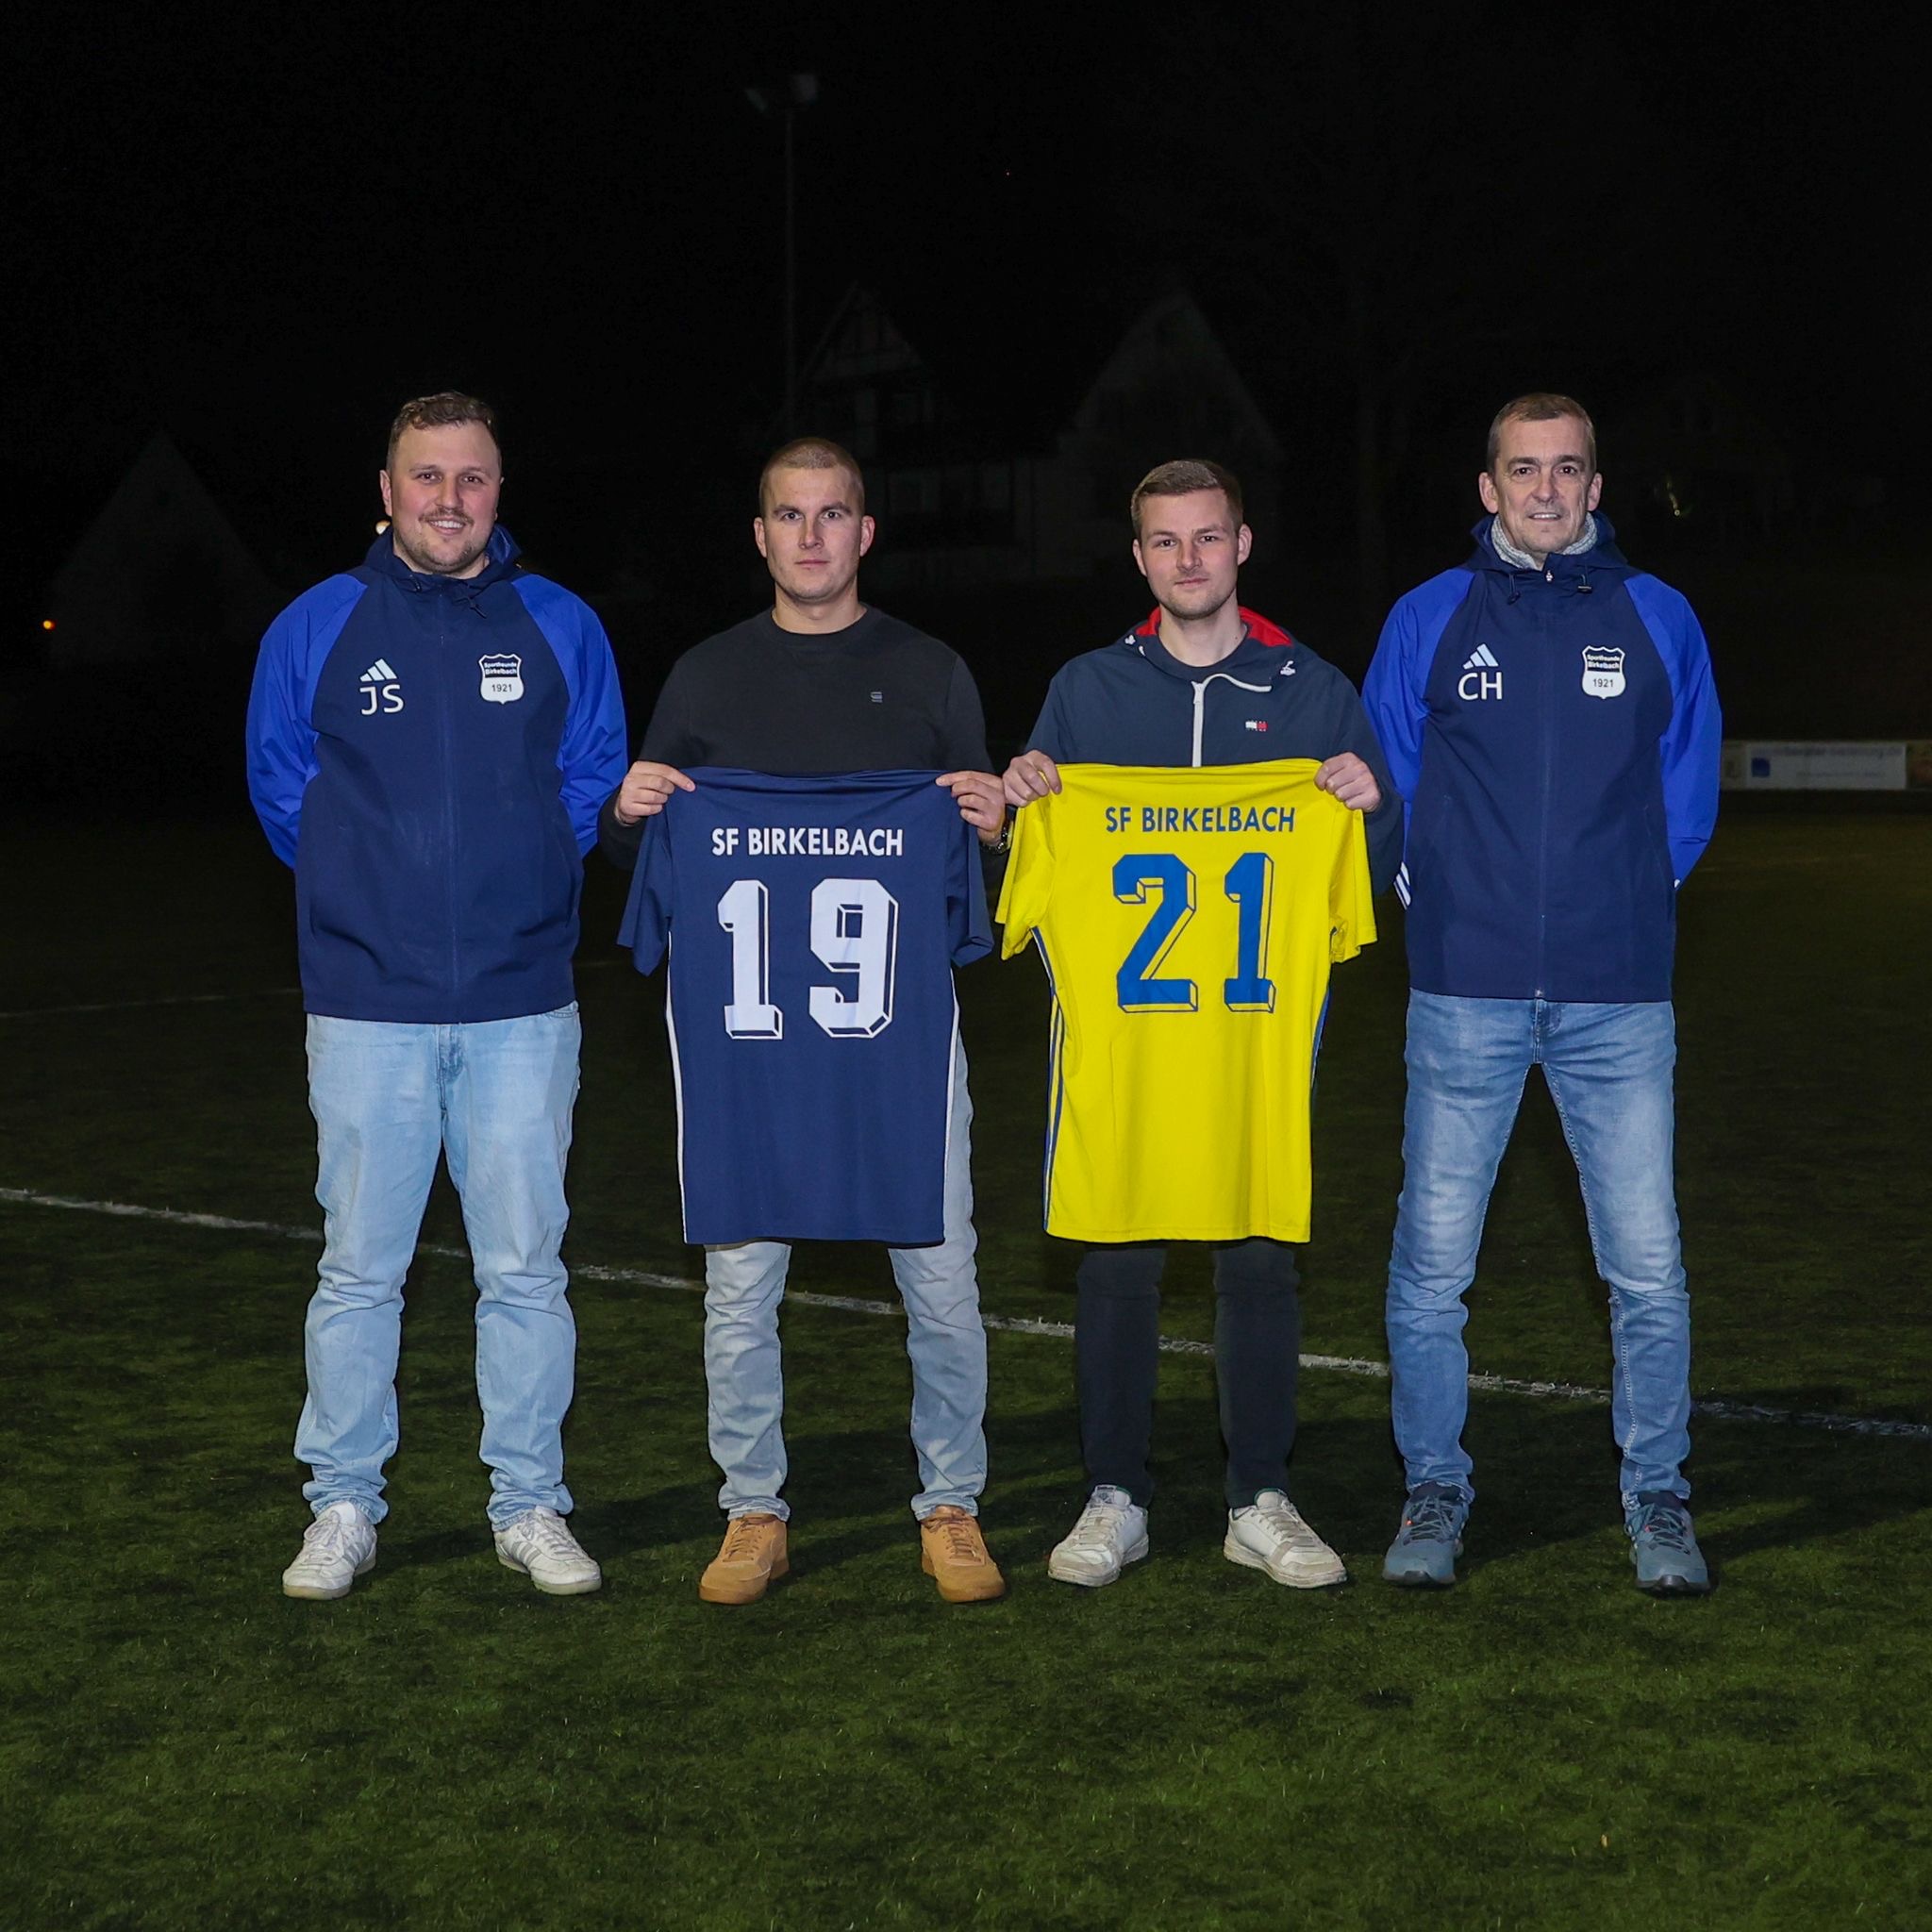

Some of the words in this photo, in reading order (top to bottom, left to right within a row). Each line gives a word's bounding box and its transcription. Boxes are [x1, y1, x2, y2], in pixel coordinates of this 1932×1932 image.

[491, 683, 512, 692] 1921
[1457, 671, 1503, 701] CH
[1592, 678, 1614, 688] 1921
[358, 683, 405, 716] JS
[1106, 807, 1131, 832] SF
[1142, 807, 1295, 832] BIRKELBACH
[712, 827, 739, 856] SF
[748, 827, 903, 856] BIRKELBACH
[1112, 852, 1276, 1013] 21
[717, 878, 898, 1040] 19
